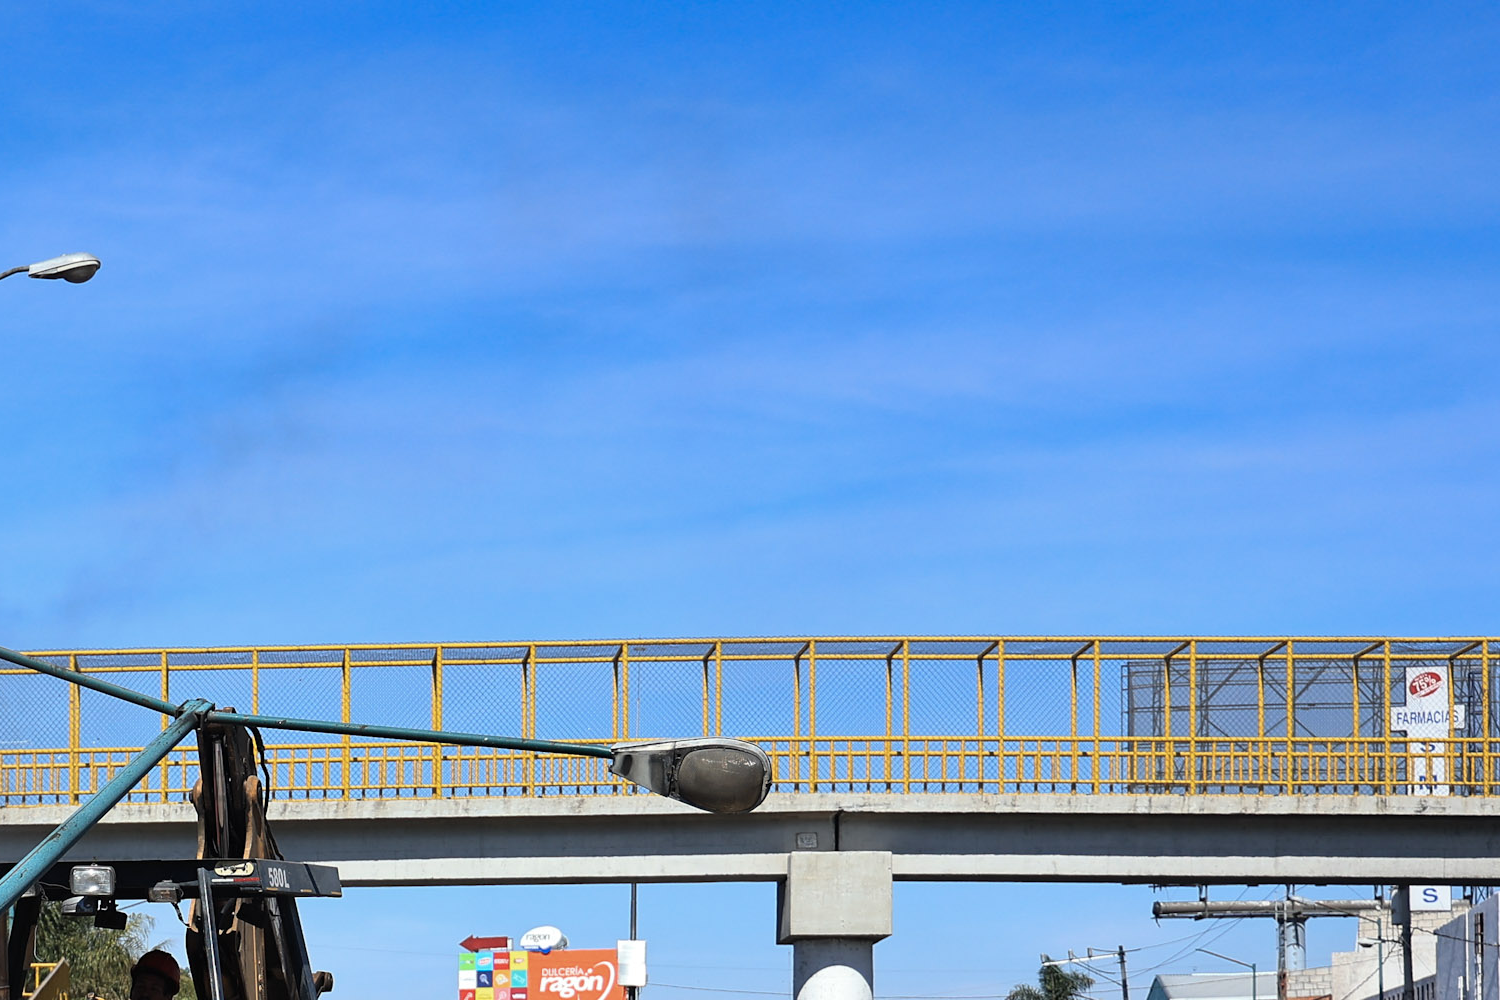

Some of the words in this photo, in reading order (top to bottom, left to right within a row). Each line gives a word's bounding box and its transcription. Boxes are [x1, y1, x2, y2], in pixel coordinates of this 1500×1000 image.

[1396, 710, 1459, 725] FARMACIAS
[268, 867, 290, 889] 580L
[541, 965, 584, 977] DULCERÍA
